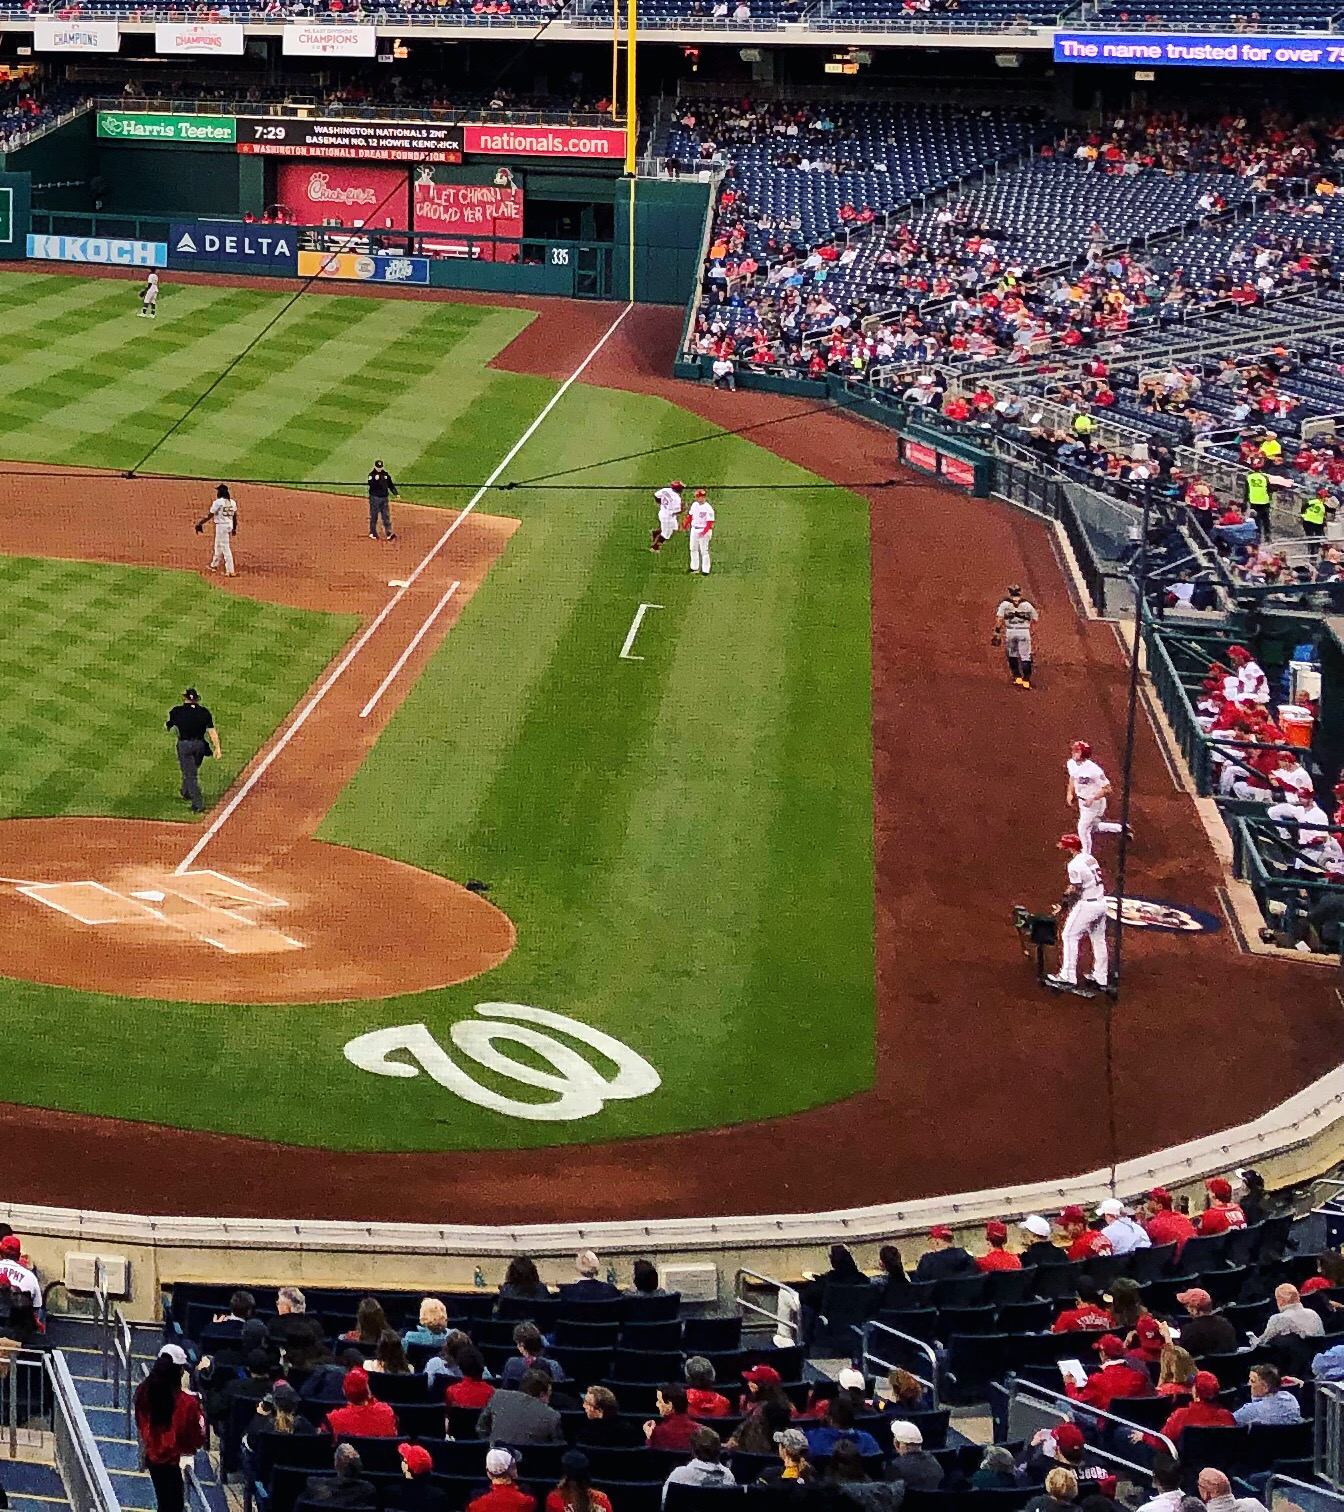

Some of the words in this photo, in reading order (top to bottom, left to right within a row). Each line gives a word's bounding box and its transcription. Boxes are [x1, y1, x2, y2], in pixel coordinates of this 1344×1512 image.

[299, 35, 358, 45] CHAMPIONS
[1060, 40, 1097, 57] The
[1103, 45, 1162, 59] name
[1166, 44, 1237, 60] trusted
[1241, 44, 1271, 61] for
[1275, 48, 1322, 62] over
[122, 121, 174, 138] Harris
[178, 122, 232, 139] Teeter
[254, 126, 285, 139] 7:29
[314, 125, 374, 136] WASHINGTON
[376, 127, 427, 138] NATIONALS
[306, 135, 350, 147] BASEMAN
[369, 138, 377, 147] 12
[380, 139, 410, 148] HOWIE
[480, 132, 608, 153] nationals.com
[66, 240, 158, 265] KOCH
[204, 235, 291, 256] DELTA
[551, 248, 569, 265] 335
